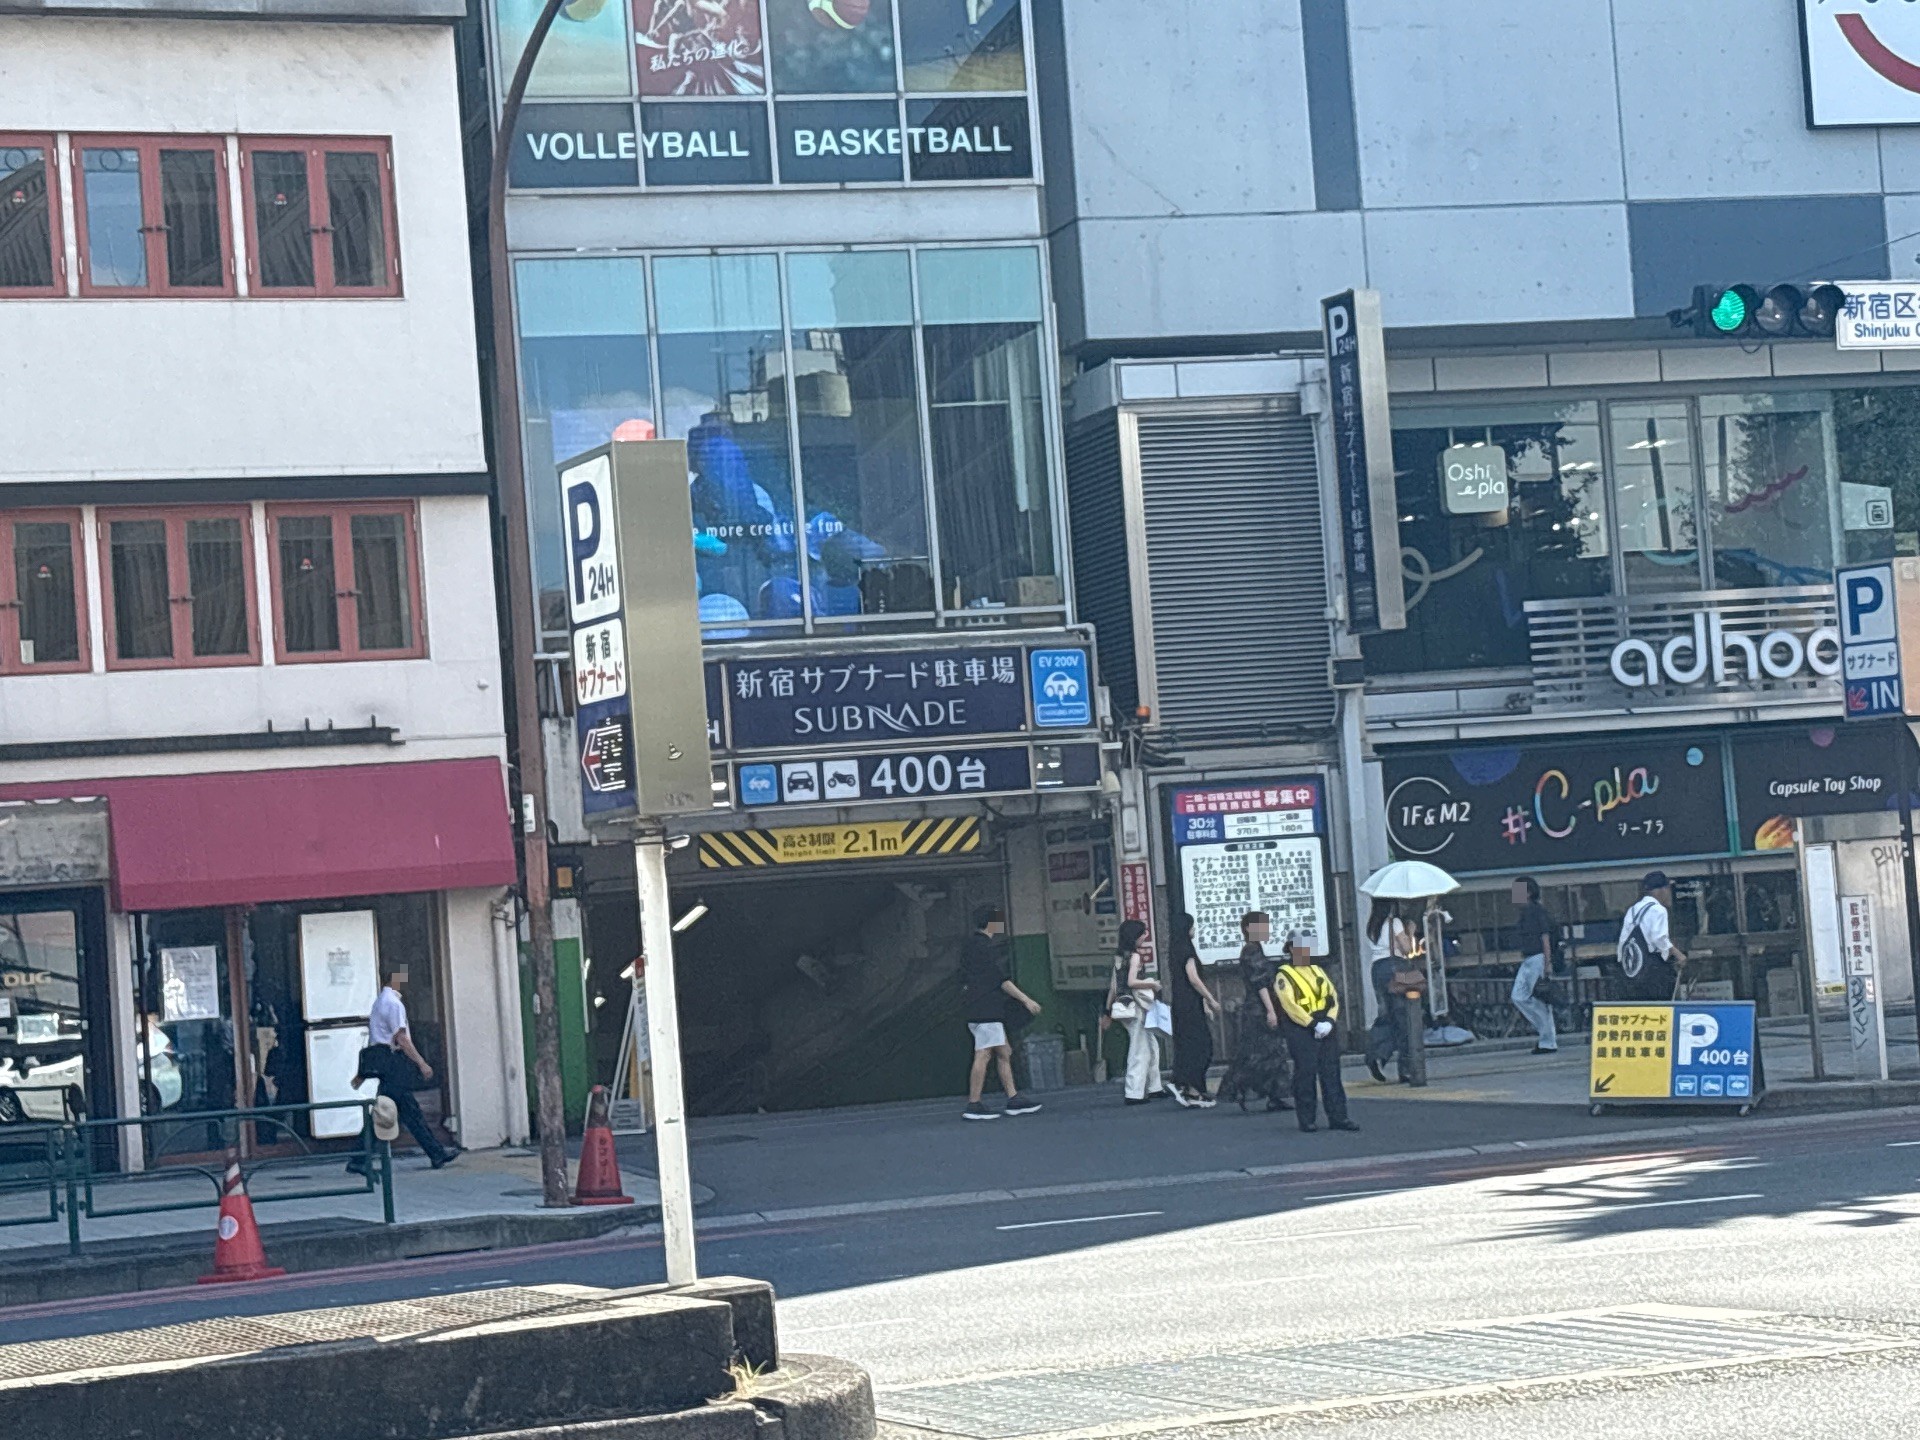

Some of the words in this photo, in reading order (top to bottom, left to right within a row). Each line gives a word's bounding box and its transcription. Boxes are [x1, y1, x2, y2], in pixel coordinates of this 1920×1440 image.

[527, 130, 750, 160] VOLLEYBALL
[794, 124, 1012, 156] BASKETBALL
[1843, 292, 1920, 320] 新宿区
[1328, 305, 1348, 356] P
[1854, 322, 1910, 340] Shinjuku
[1448, 463, 1491, 481] Oshi
[568, 481, 601, 605] P
[706, 525, 744, 538] more
[750, 522, 812, 537] creatie
[818, 519, 843, 534] fun
[589, 563, 615, 600] 24H
[1847, 576, 1883, 636] P
[586, 630, 611, 668] 新宿
[1039, 656, 1052, 668] EV
[1054, 655, 1079, 667] 200V
[1847, 651, 1895, 670] サブナード
[579, 661, 622, 699] サブナード
[736, 655, 1016, 699] 新宿サブナード駐車場
[1871, 679, 1900, 710] IN
[794, 699, 967, 734] SUBNADE
[871, 755, 986, 795] 400台
[1769, 779, 1820, 798] Capsule
[1823, 777, 1846, 795] Toy
[1849, 775, 1882, 793] Shop
[783, 831, 836, 850] 高さ制限
[843, 829, 898, 854] 2.1m
[1678, 1013, 1719, 1066] P
[1699, 1049, 1749, 1065] 400台
